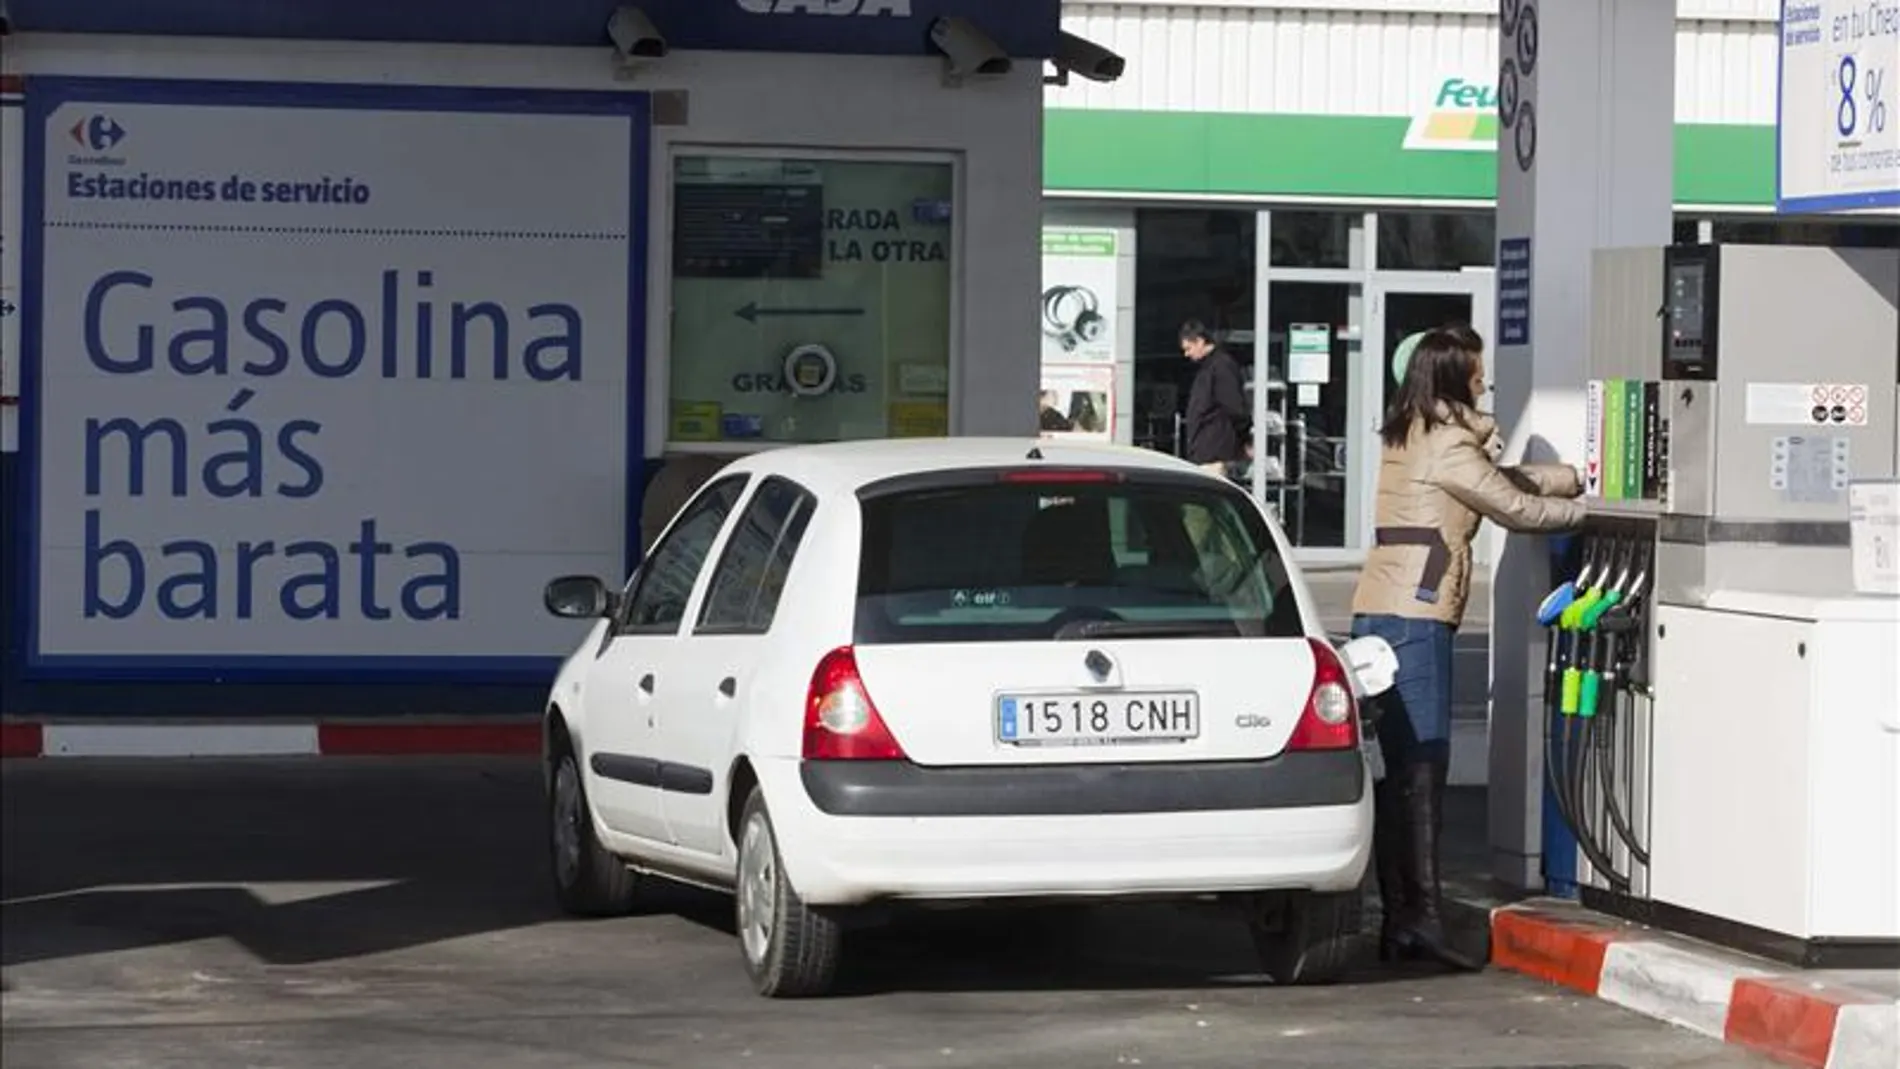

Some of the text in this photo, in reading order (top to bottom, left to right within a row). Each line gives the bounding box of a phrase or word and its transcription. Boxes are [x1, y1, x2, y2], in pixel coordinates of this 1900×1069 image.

[1838, 55, 1886, 137] 8 %
[68, 171, 370, 205] Estaciones de servicio
[822, 208, 900, 230] RADA
[828, 240, 946, 262] LA OTRA
[84, 269, 583, 381] Gasolina
[732, 373, 866, 393] GRAAS
[84, 388, 324, 498] más
[83, 510, 460, 620] barata
[1025, 699, 1191, 733] 1518 CNH
